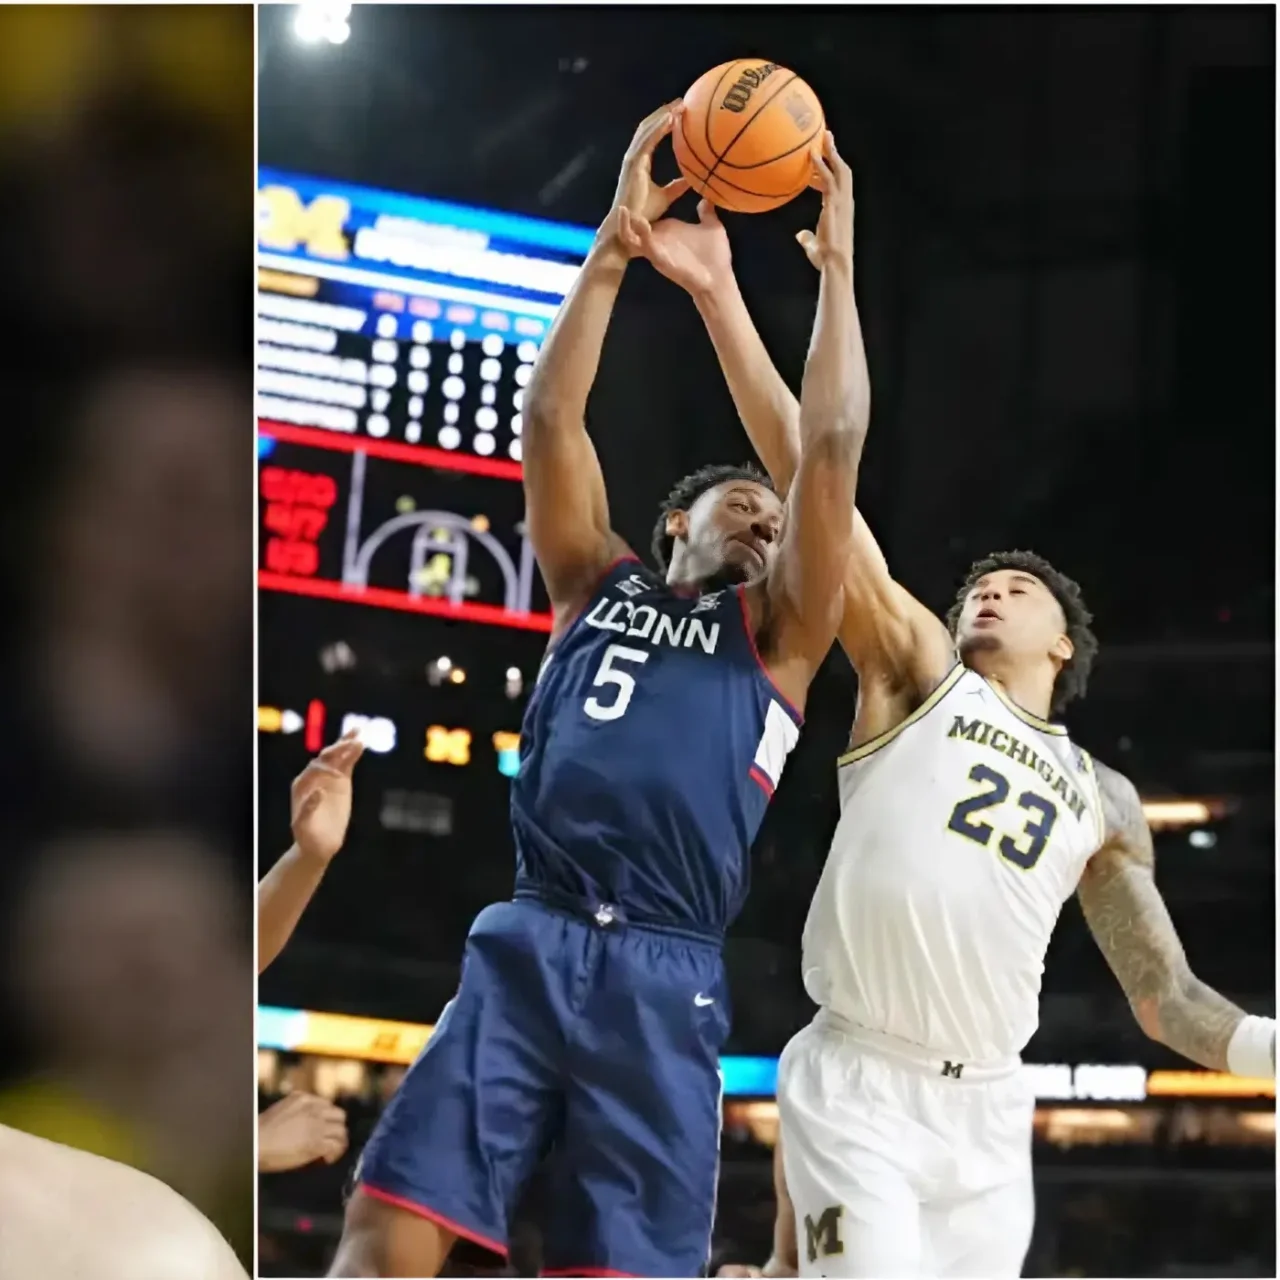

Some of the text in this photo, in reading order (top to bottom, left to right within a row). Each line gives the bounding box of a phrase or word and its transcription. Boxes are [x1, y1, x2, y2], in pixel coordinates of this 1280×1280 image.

[583, 644, 650, 722] 5
[946, 762, 1058, 871] 23
[947, 716, 1086, 824] MICHIGAN
[803, 1204, 846, 1264] M
